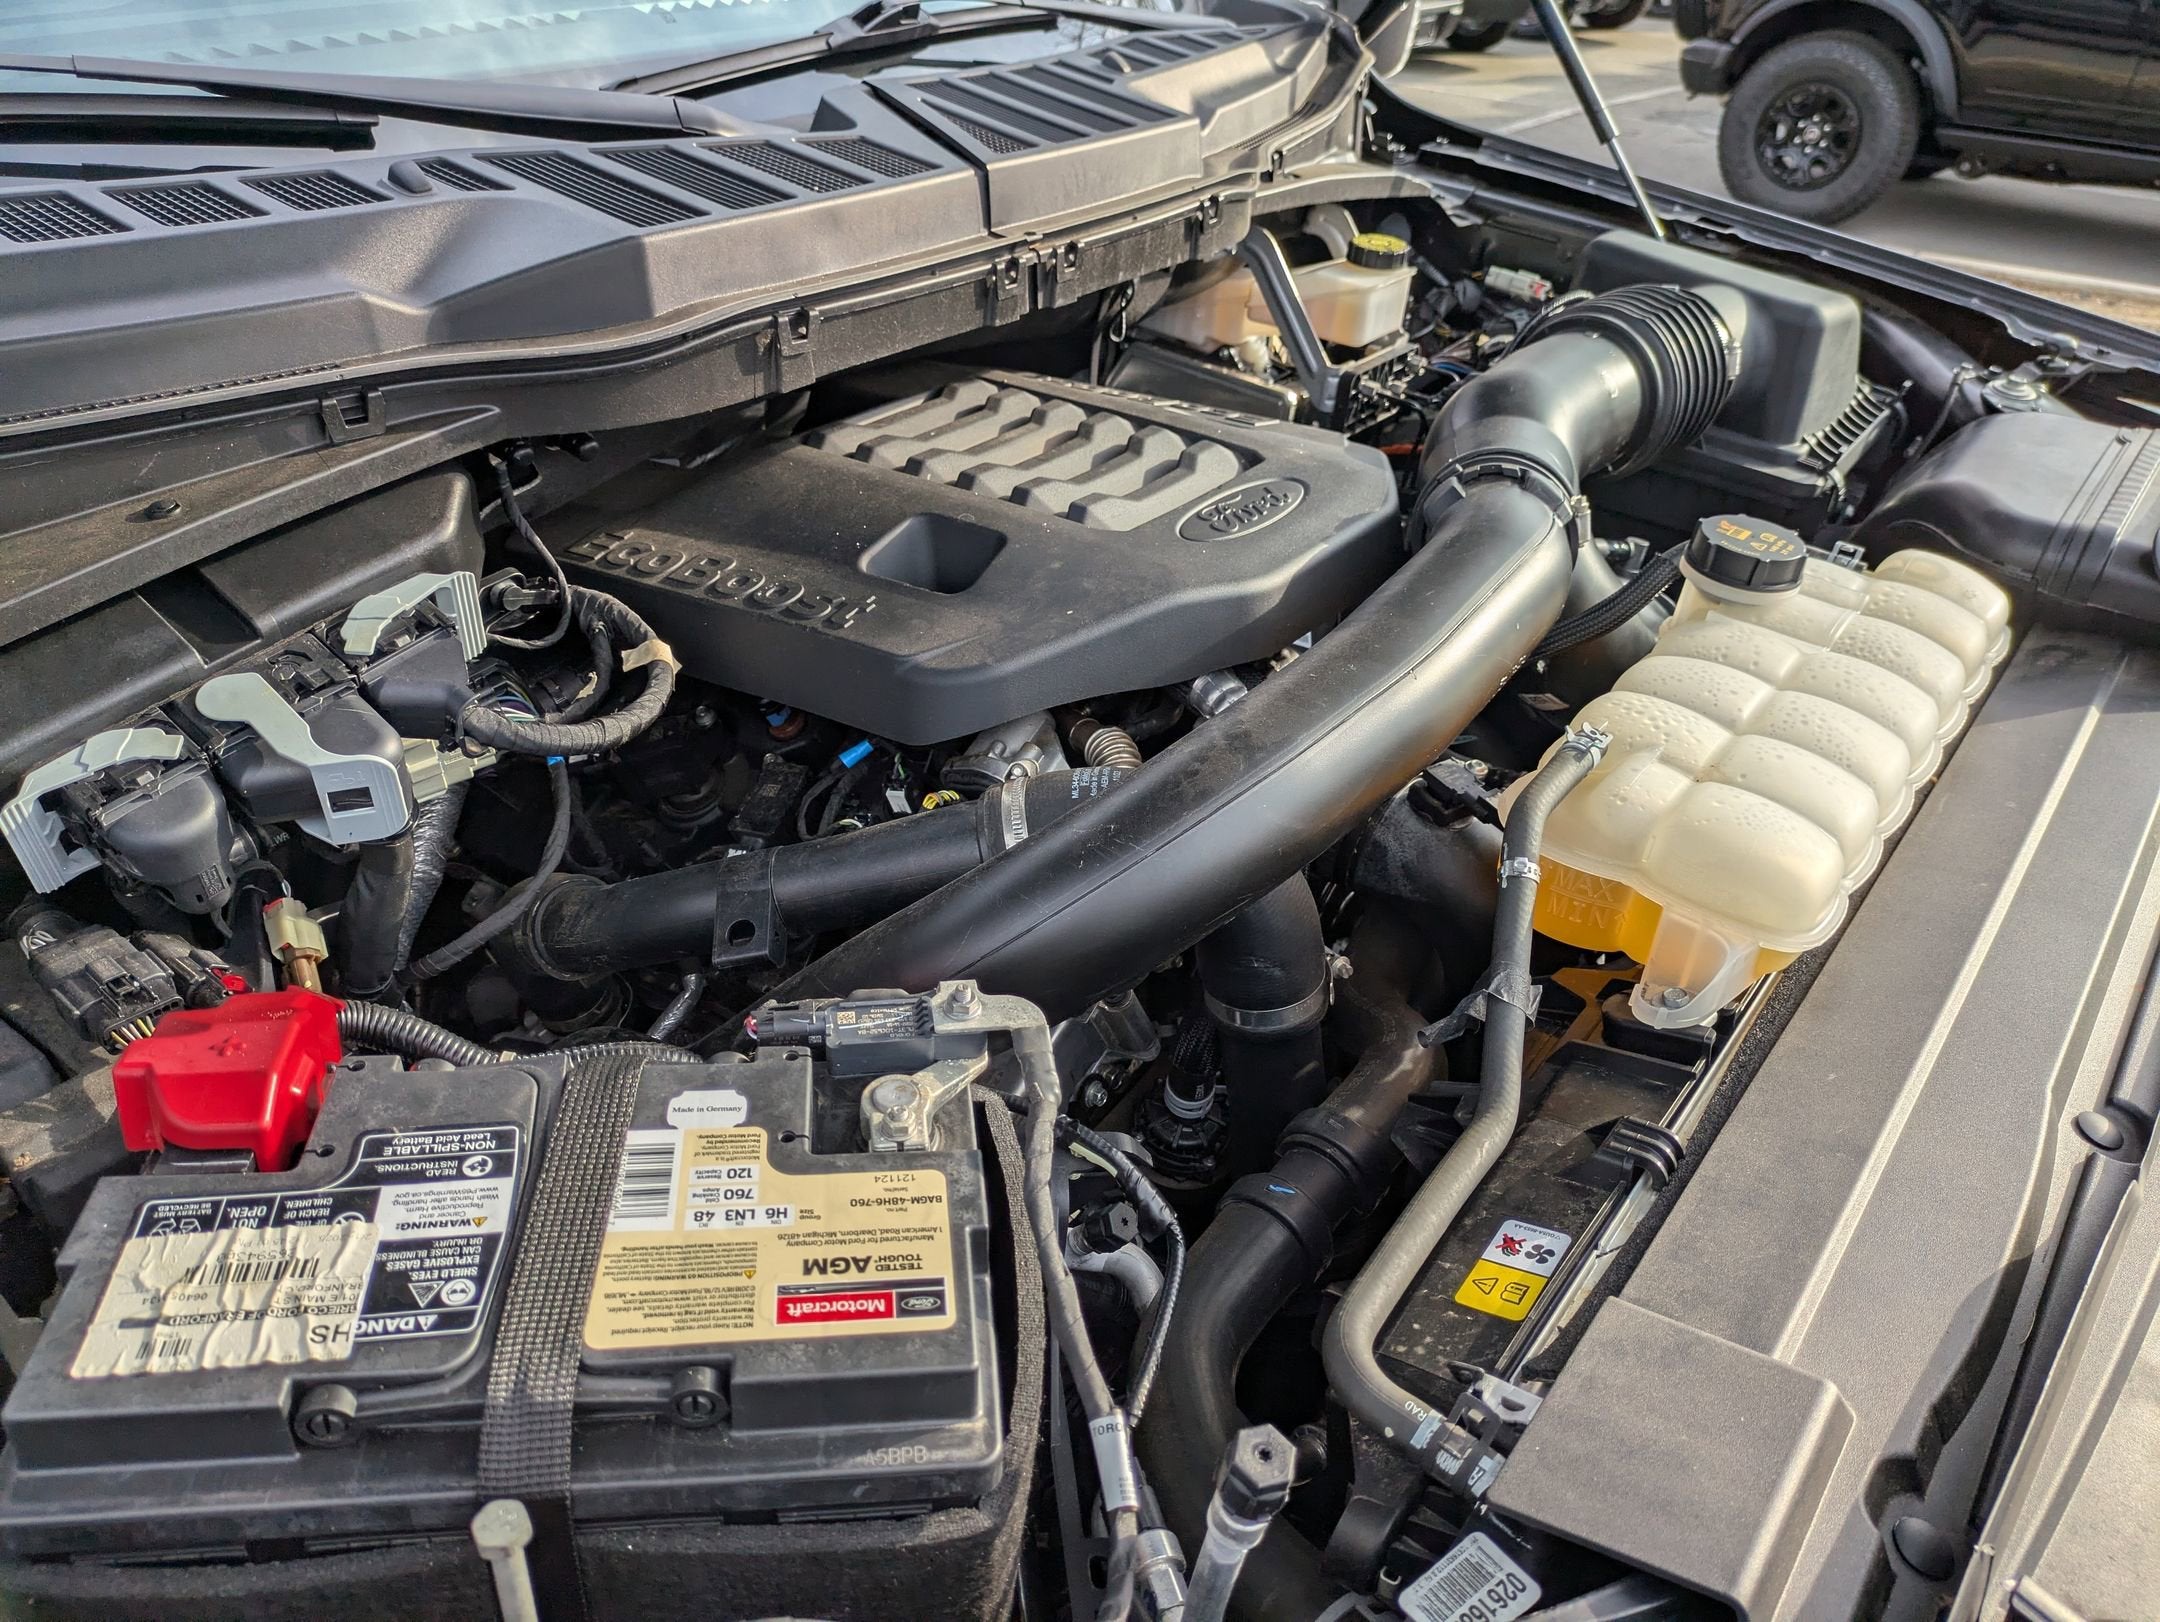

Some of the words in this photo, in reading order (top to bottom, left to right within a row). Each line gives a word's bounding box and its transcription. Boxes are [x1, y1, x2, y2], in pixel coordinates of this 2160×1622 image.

[1197, 486, 1291, 533] Ford
[1555, 868, 1617, 902] MAX
[1546, 894, 1612, 929] MIN
[706, 1105, 742, 1113] Germany
[392, 1136, 433, 1145] Battery
[435, 1134, 461, 1143] Acid
[463, 1132, 490, 1141] Lead
[383, 1140, 496, 1156] NON-SPILLABLE
[374, 1160, 459, 1173] INSTRUCTIONS.
[425, 1168, 457, 1177] READ
[727, 1168, 752, 1179] 120
[874, 1173, 916, 1183] 121124
[449, 1194, 475, 1202] hands
[476, 1193, 499, 1201] Wash
[724, 1188, 754, 1200] 760
[283, 1197, 333, 1208] CHILDREN.
[391, 1197, 428, 1207] handling.
[429, 1196, 448, 1204] after
[850, 1195, 942, 1207] BAGM-48H6-760
[157, 1203, 199, 1211] RECYCLED
[226, 1205, 267, 1218] OPEN.
[431, 1202, 483, 1211] Reproductive
[176, 1208, 211, 1217] BATTERY
[283, 1211, 296, 1219] OF
[299, 1207, 330, 1218] REACH
[437, 1211, 466, 1219] Cancer
[694, 1211, 715, 1222] 48
[725, 1208, 755, 1221] LN3
[765, 1207, 788, 1219] H6
[231, 1218, 259, 1229] NOT
[395, 1218, 472, 1231] WARNING:
[802, 1230, 837, 1240] Michigan
[839, 1228, 877, 1238] Dearborn,
[878, 1227, 900, 1236] Road,
[901, 1226, 938, 1235] American
[432, 1238, 468, 1248] INJURY.
[469, 1237, 483, 1245] OR
[786, 1238, 823, 1248] Company
[824, 1238, 847, 1246] Motor
[848, 1237, 865, 1245] Ford
[867, 1236, 878, 1244] for
[880, 1234, 934, 1243] Manufactured
[430, 1247, 460, 1257] CAUSE
[462, 1245, 481, 1255] CAN
[374, 1250, 428, 1261] BLINDNESS
[385, 1260, 420, 1271] GASES
[422, 1255, 480, 1268] EXPLOSIVE
[803, 1255, 872, 1276] AGM
[441, 1266, 478, 1278] SHIELD
[875, 1262, 923, 1272] TESTED
[408, 1270, 439, 1281] EYES.
[697, 1271, 743, 1279] PROPOSITION
[294, 1294, 326, 1303] MAIN
[329, 1294, 338, 1302] E
[709, 1299, 744, 1307] complete
[786, 1298, 886, 1317] Motorcraft
[355, 1316, 416, 1333] DANG
[309, 1322, 352, 1344] HS
[611, 1327, 641, 1335] required
[1404, 1400, 1428, 1422] RAD
